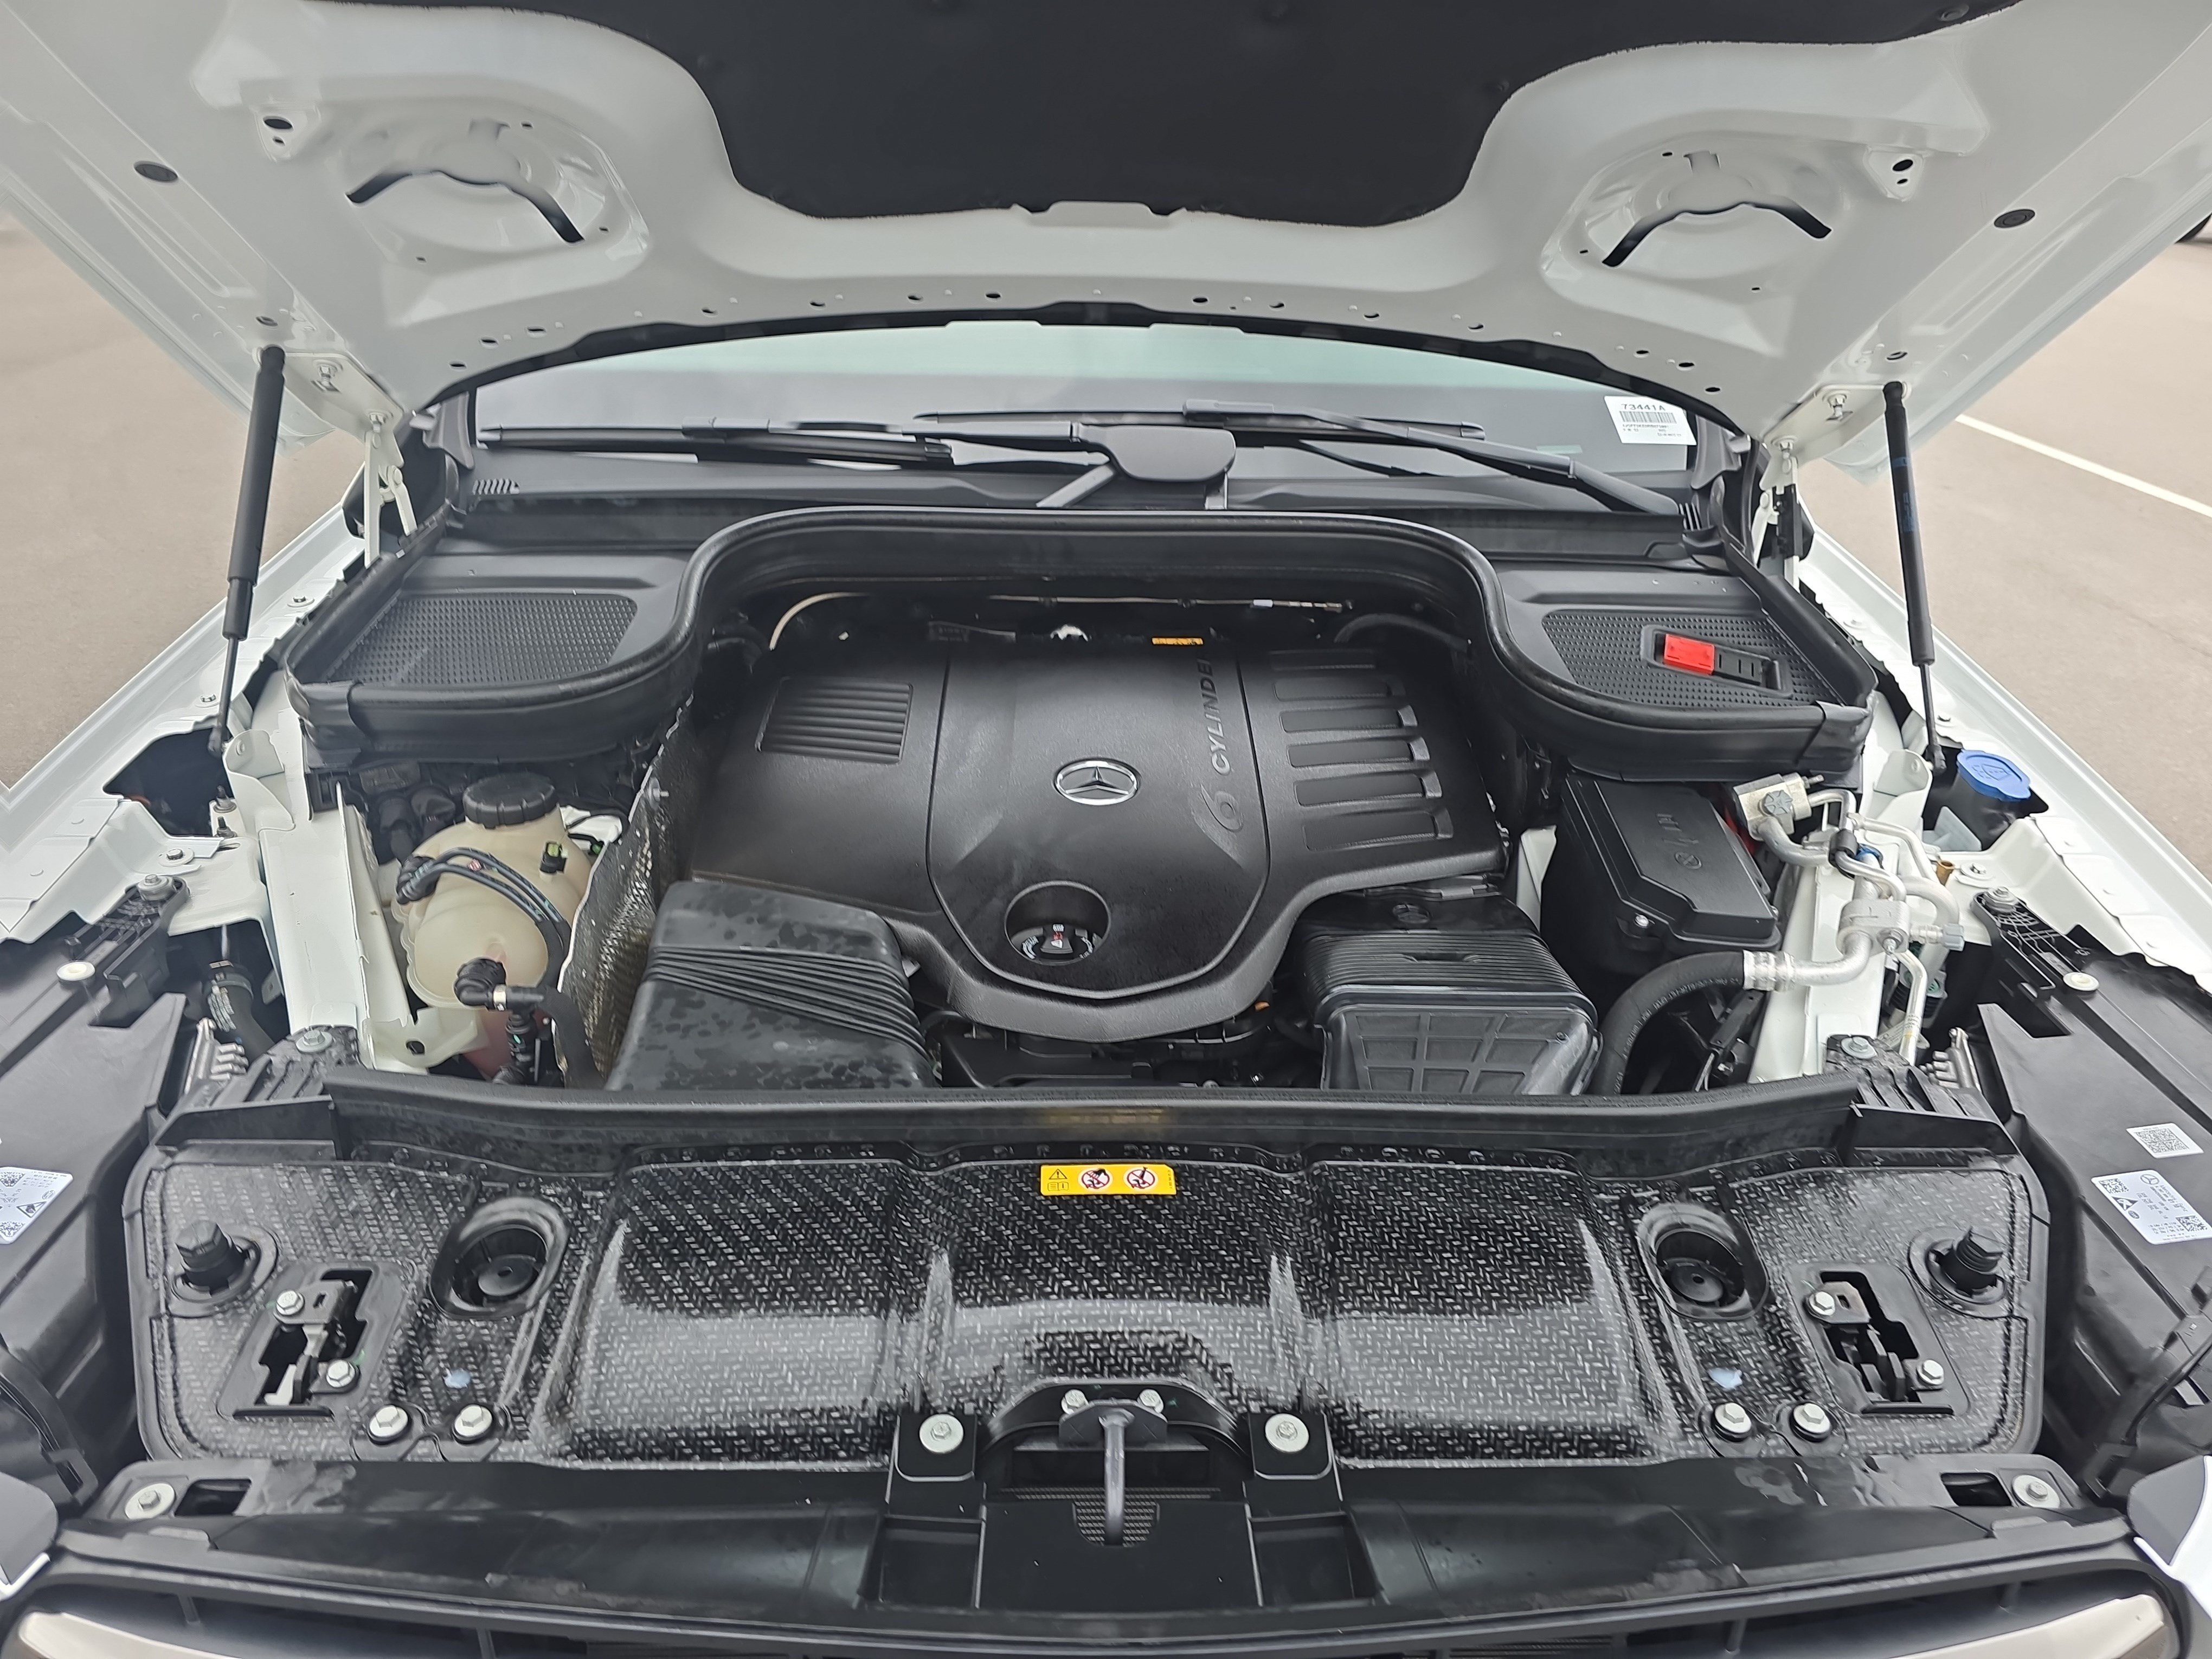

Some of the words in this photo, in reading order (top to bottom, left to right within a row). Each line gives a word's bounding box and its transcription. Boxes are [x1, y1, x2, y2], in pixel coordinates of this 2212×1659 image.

[1621, 403, 1666, 411] 73441A
[1196, 652, 1231, 776] CYLINDE
[1199, 783, 1245, 833] 6
